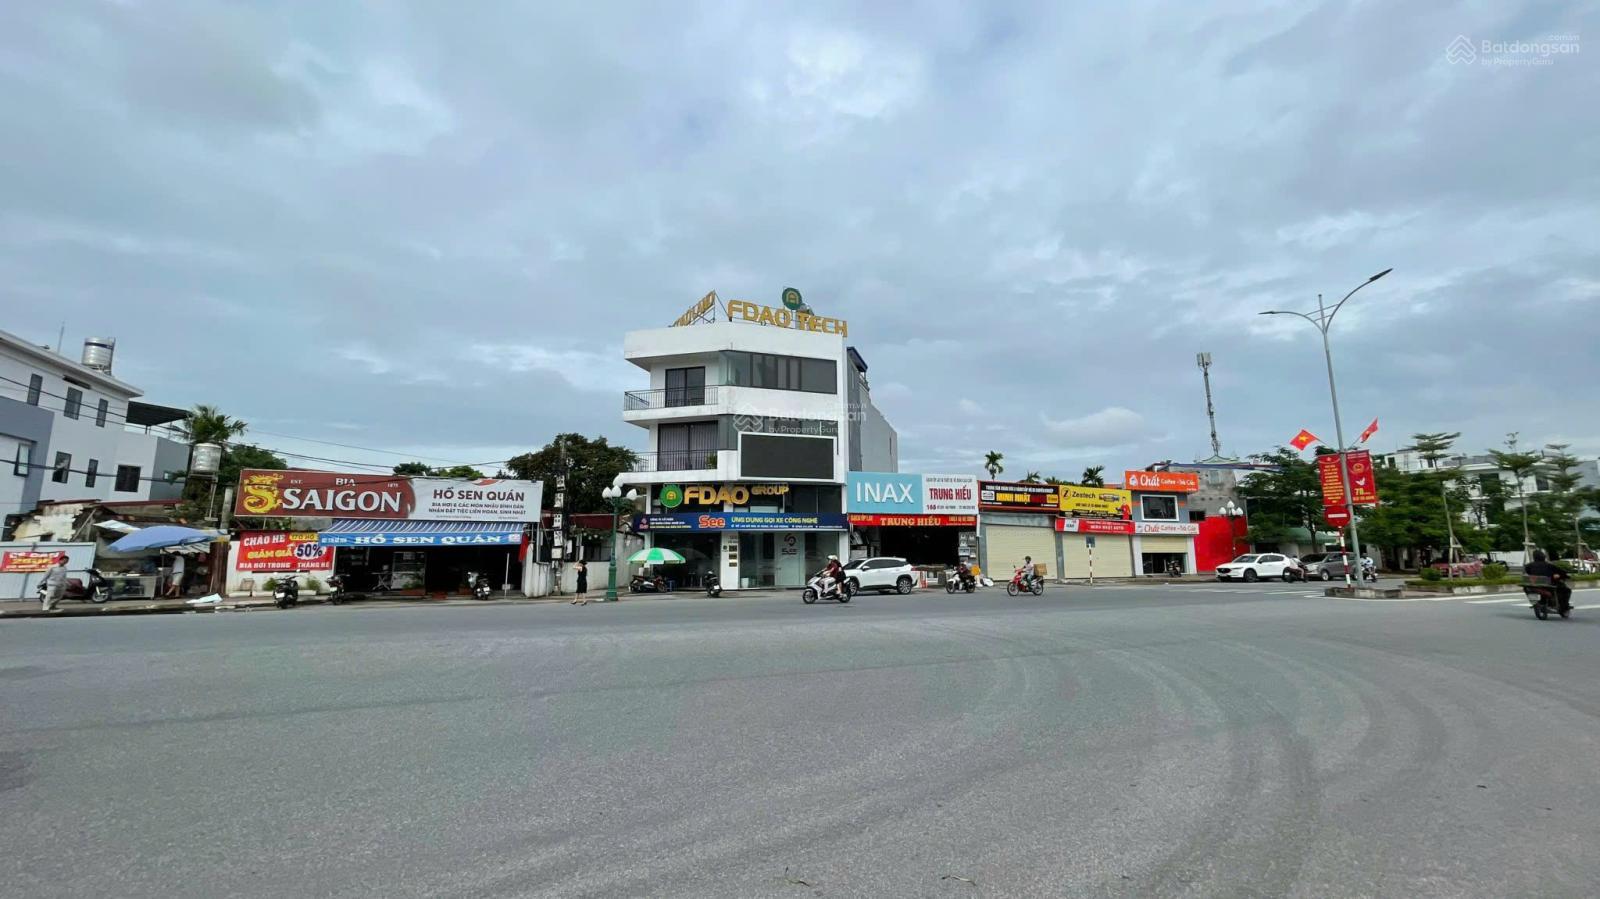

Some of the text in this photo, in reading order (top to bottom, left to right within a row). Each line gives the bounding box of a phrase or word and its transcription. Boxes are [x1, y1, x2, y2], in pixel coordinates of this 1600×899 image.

[728, 300, 848, 337] FDAO TECH
[335, 478, 356, 487] BIA
[1141, 474, 1159, 486] Chất
[458, 490, 482, 500] SEN
[486, 489, 524, 501] QUÁN
[684, 486, 749, 505] FDAO
[751, 485, 789, 495] GROUP
[856, 482, 914, 504] INAX
[929, 488, 953, 500] TRUNG
[955, 485, 971, 500] HIẾU
[282, 488, 401, 512] SAIGON
[698, 514, 726, 528] See
[881, 518, 915, 526] TRUNG
[918, 516, 941, 526] HIẾU
[441, 534, 500, 544] QUÁN
[296, 543, 322, 557] 50%
